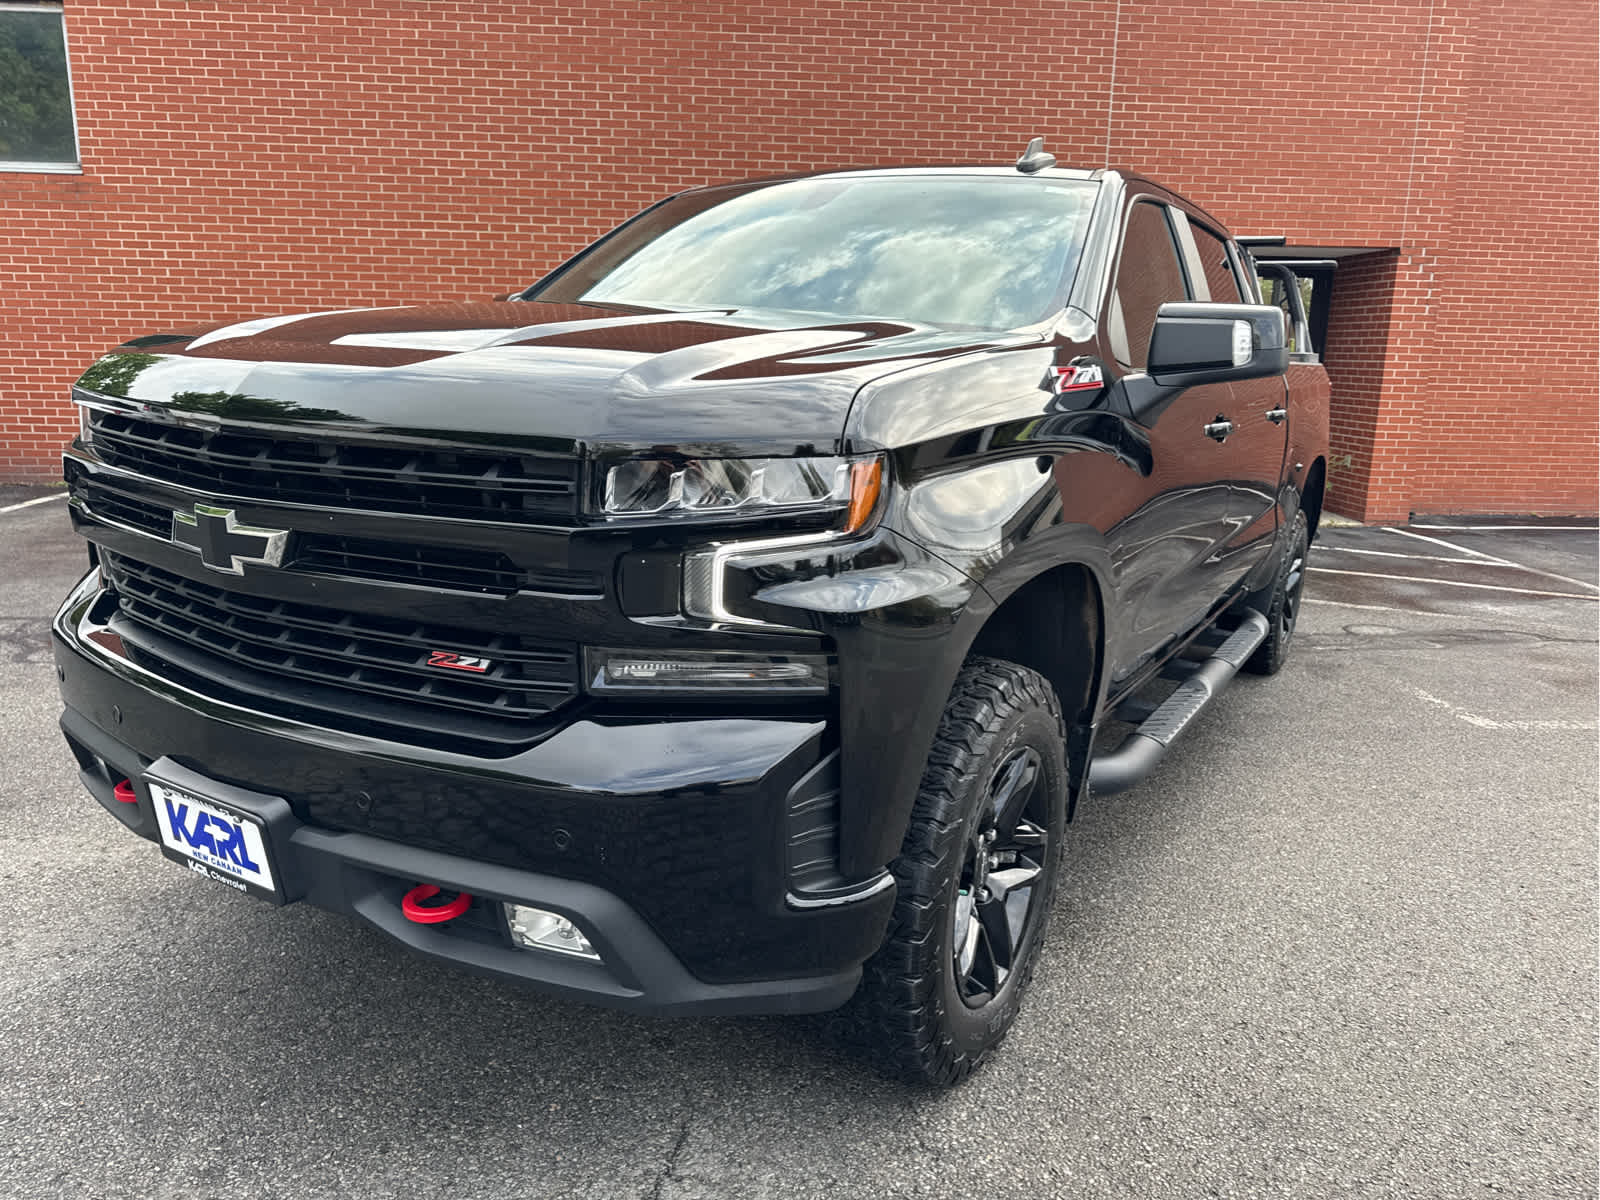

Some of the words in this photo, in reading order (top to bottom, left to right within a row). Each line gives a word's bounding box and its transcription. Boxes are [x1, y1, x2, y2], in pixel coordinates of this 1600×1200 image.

[427, 651, 491, 672] Z71
[164, 798, 261, 875] KARL
[192, 849, 209, 862] NEW
[210, 871, 247, 892] Chevrolet
